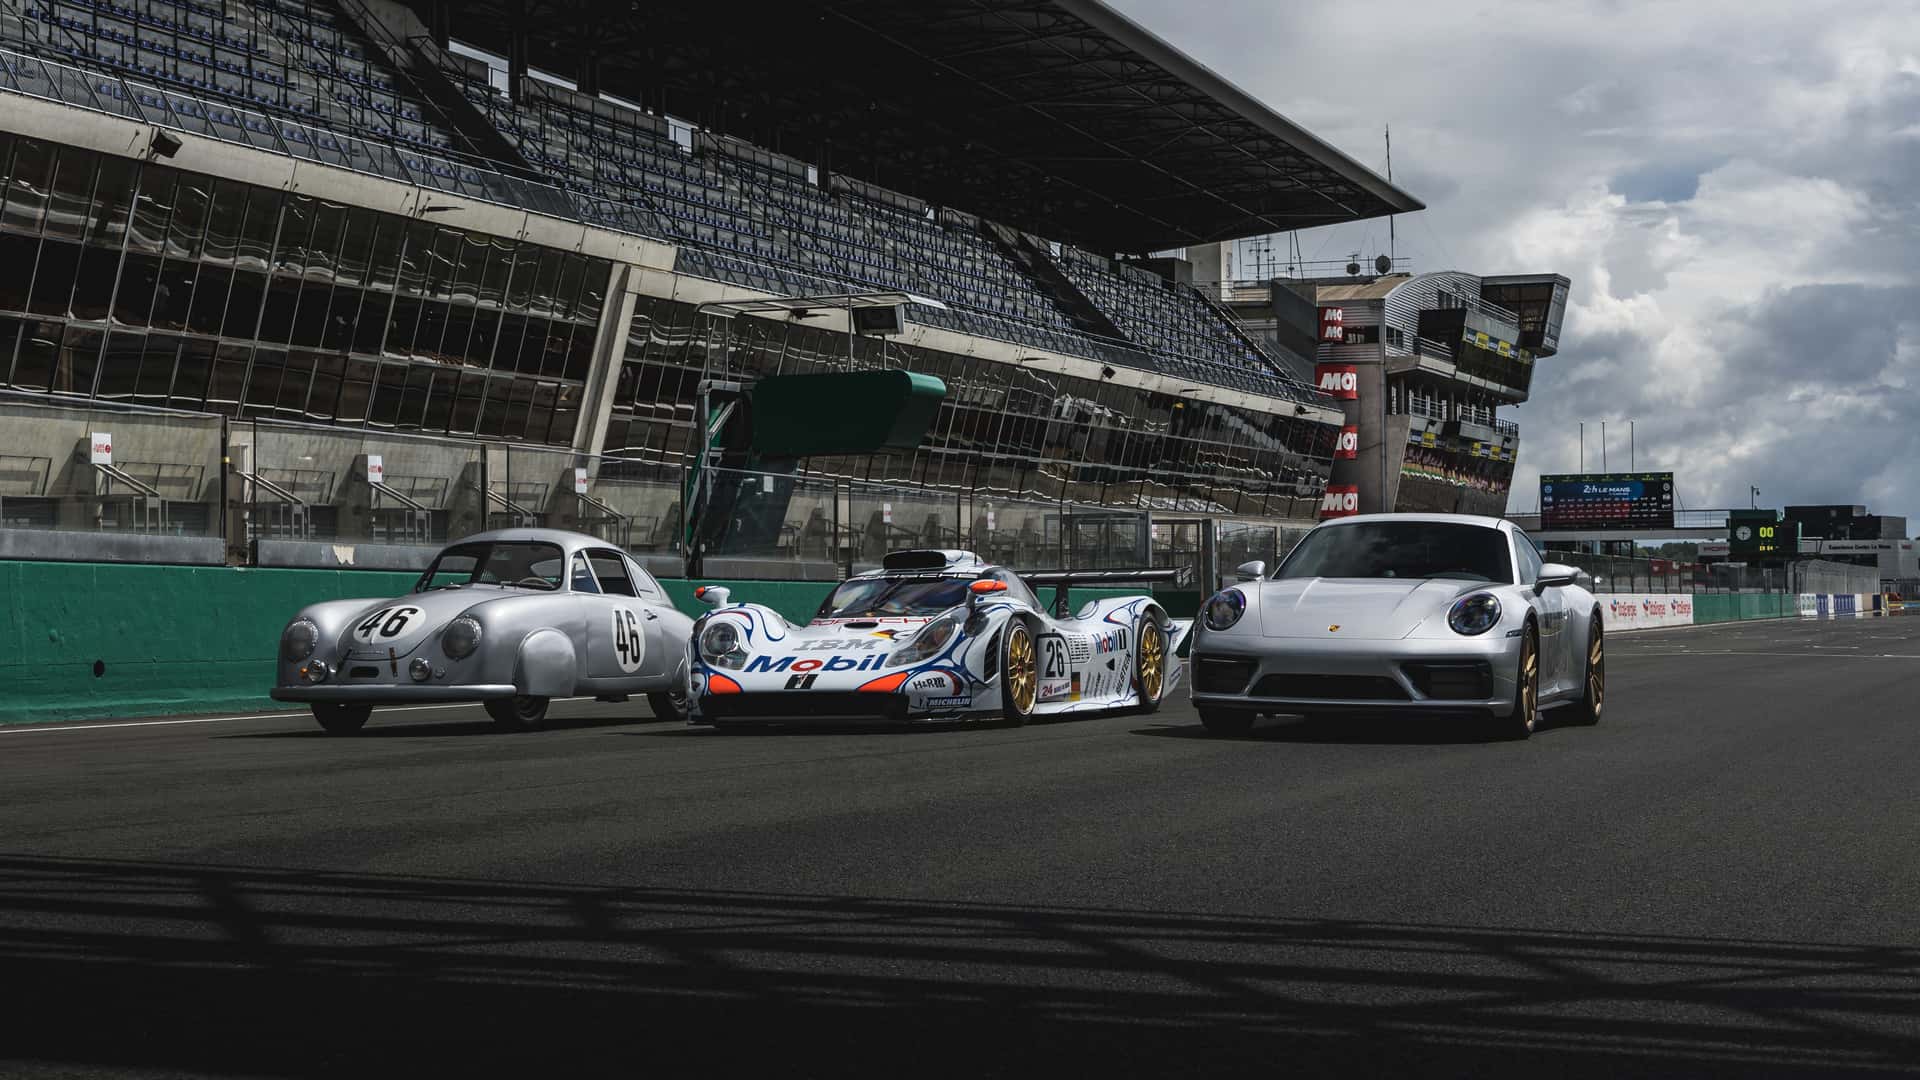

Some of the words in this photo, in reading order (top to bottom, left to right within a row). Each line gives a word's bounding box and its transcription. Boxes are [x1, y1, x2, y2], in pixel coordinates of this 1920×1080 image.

[1759, 526, 1774, 538] 00
[357, 607, 419, 638] 46
[615, 609, 641, 667] 46
[793, 639, 882, 651] IBM
[1091, 630, 1118, 655] Mobil
[743, 653, 888, 673] Mobil
[1045, 639, 1065, 678] 26
[1042, 683, 1053, 697] 24
[928, 697, 971, 706] MICHELIN
